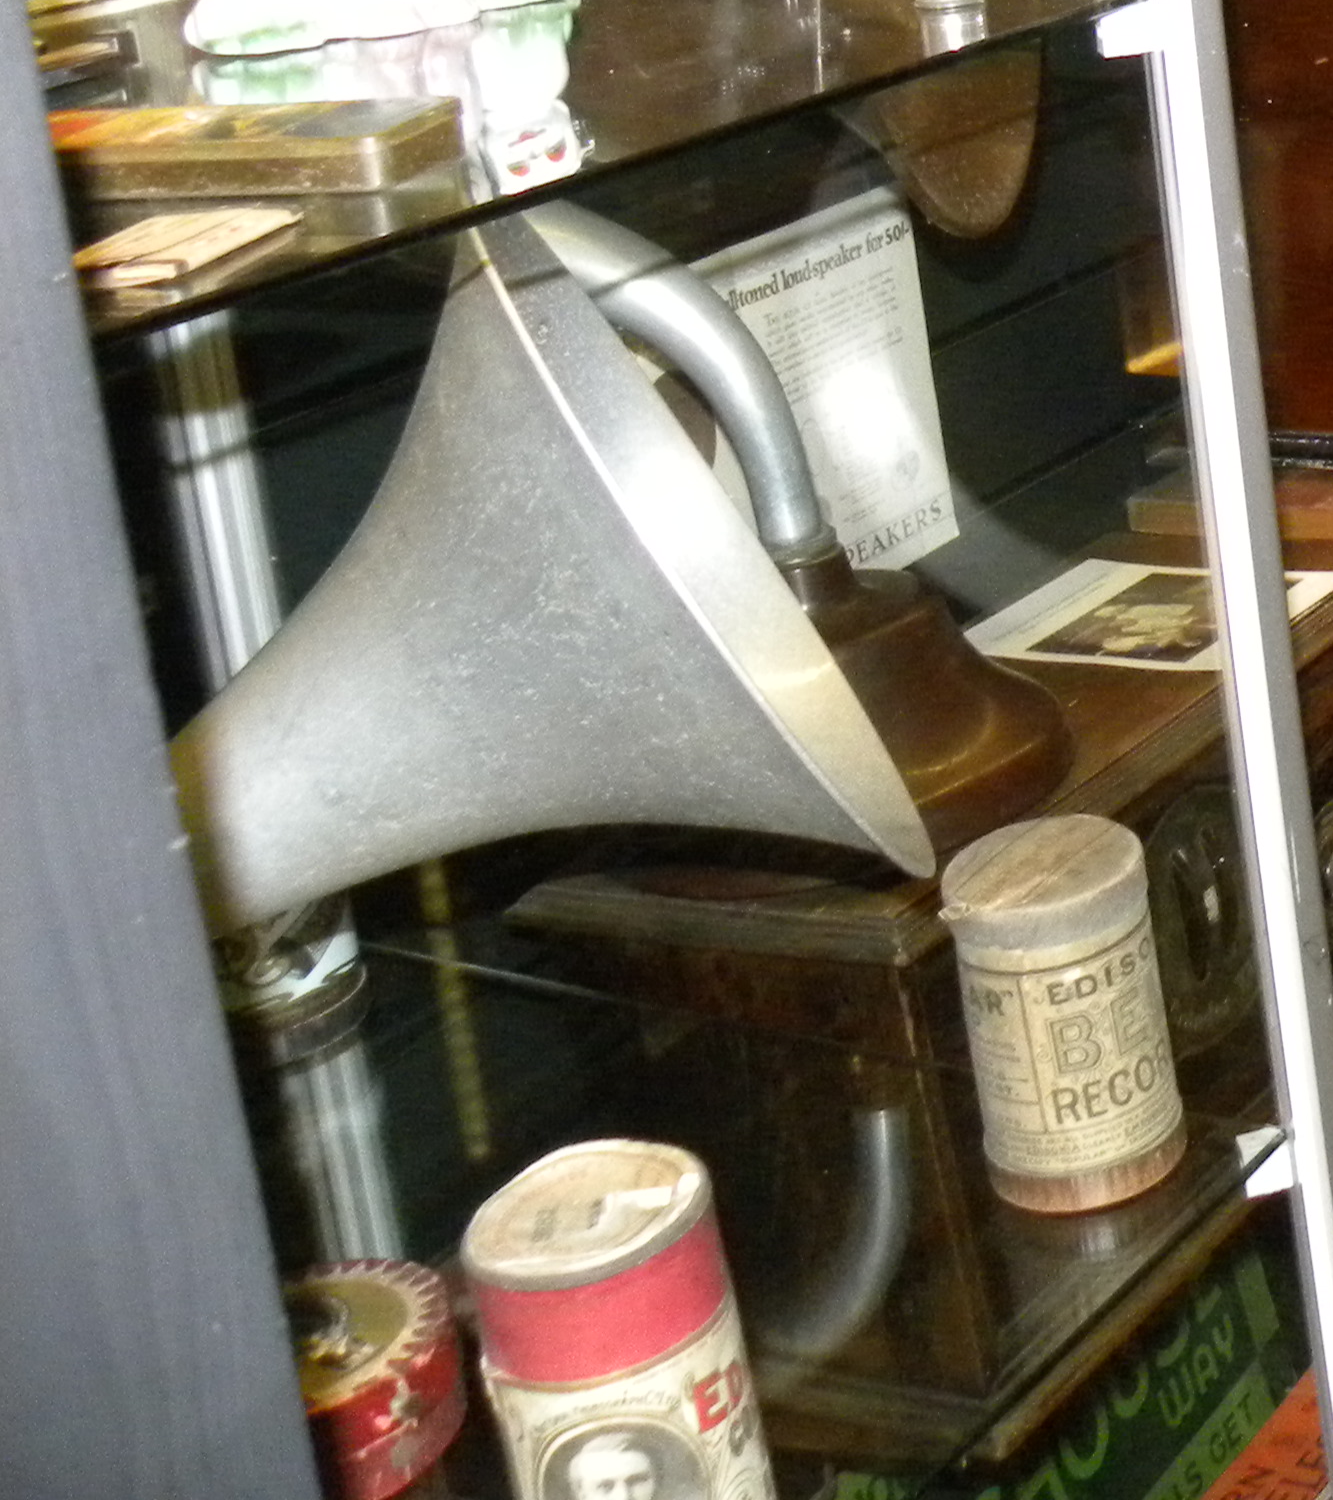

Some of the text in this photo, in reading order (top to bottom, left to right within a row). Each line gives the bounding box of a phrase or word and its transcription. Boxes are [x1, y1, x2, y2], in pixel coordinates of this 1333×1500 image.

[780, 242, 863, 286] loud-speaker
[866, 231, 884, 255] for
[885, 220, 910, 245] 50/-
[849, 499, 942, 564] PEAKERS
[1046, 936, 1156, 1006] EDISO
[1050, 1039, 1170, 1126] RECOR
[1157, 1313, 1235, 1427] WAY
[1209, 1402, 1254, 1462] GET
